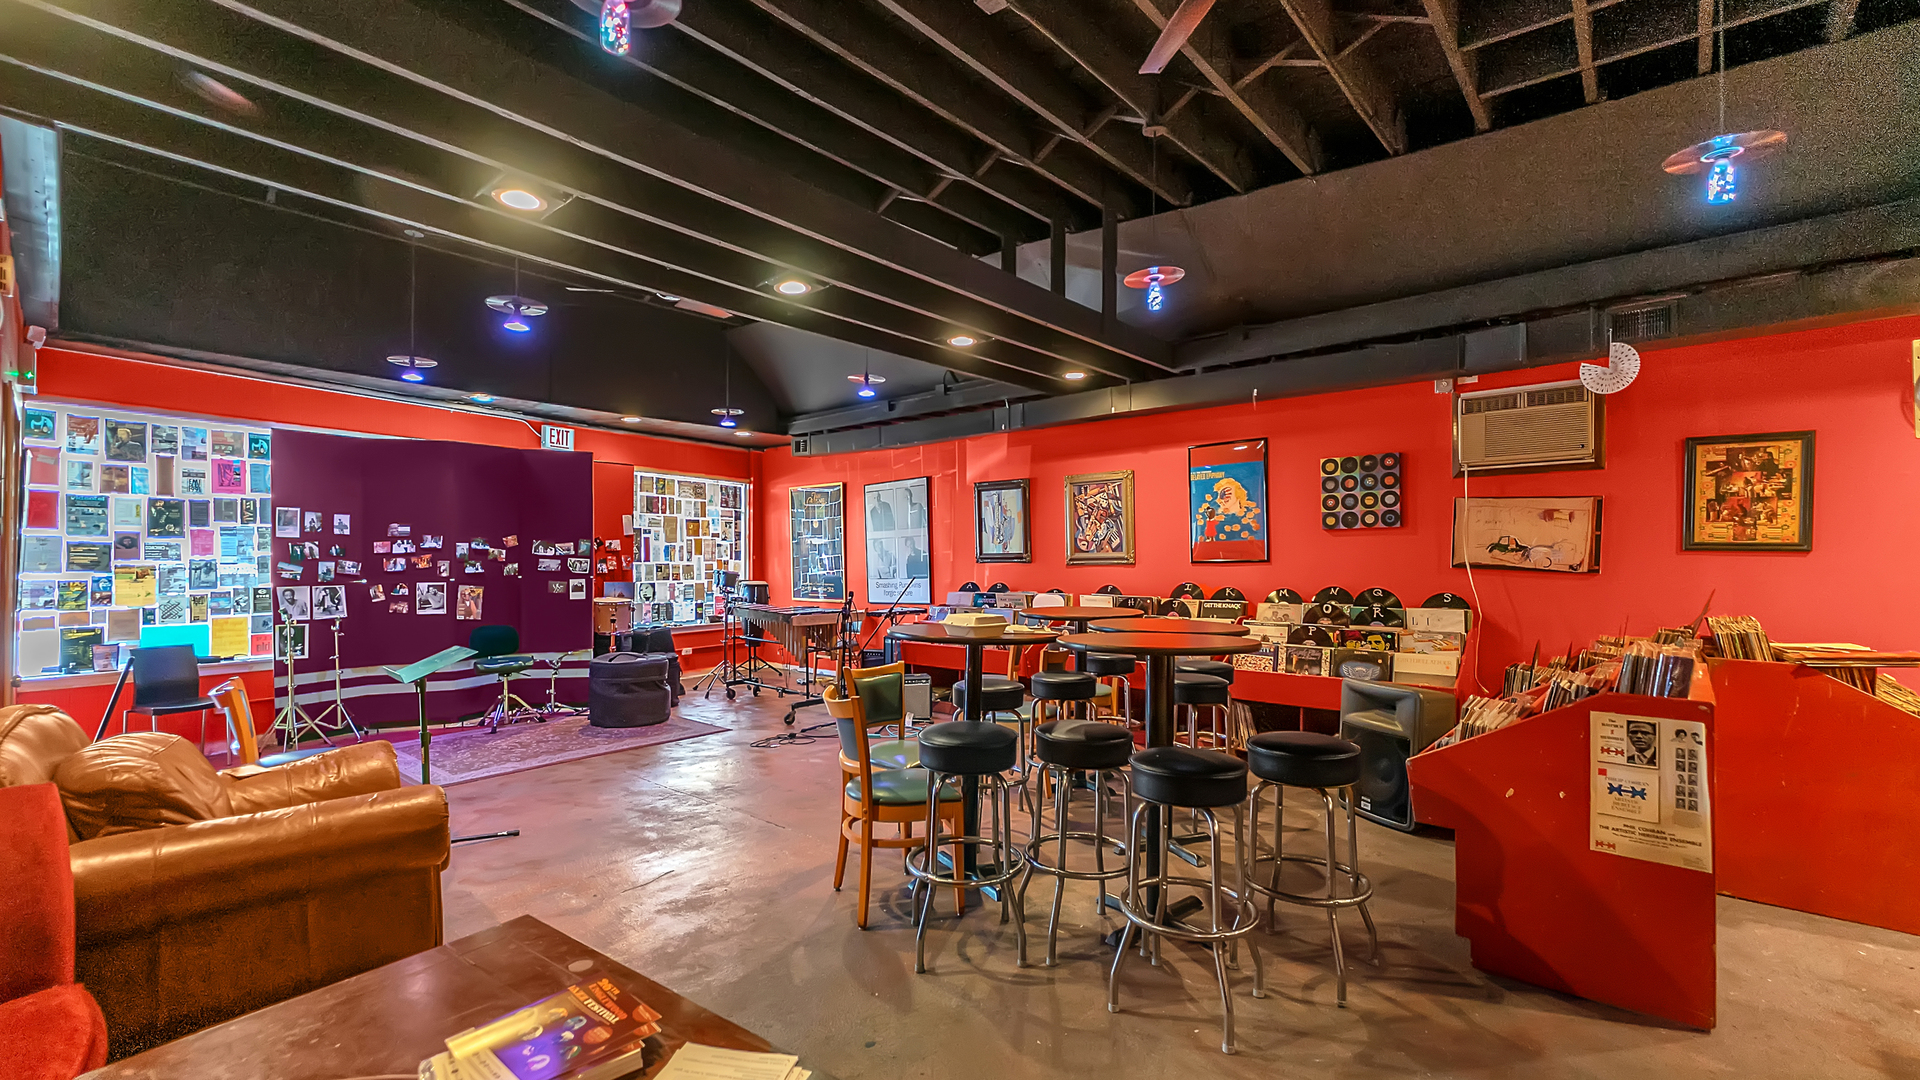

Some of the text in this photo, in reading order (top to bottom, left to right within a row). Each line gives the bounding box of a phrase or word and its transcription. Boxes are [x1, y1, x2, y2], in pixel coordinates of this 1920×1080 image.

[550, 428, 570, 446] EXIT
[875, 581, 898, 590] Smashing
[1225, 588, 1236, 597] K
[1279, 589, 1288, 597] M
[1329, 587, 1339, 595] N
[1372, 588, 1383, 597] Q
[1128, 597, 1135, 606] H
[1443, 593, 1452, 603] S
[1172, 600, 1181, 608] J
[1323, 603, 1332, 614] O
[1373, 607, 1384, 618] R
[1308, 626, 1317, 635] P
[1638, 827, 1666, 835] COHRAN
[1611, 827, 1637, 836] ARTISTIC
[1638, 832, 1668, 841] HERITAGE
[1669, 837, 1702, 847] ENSEMBLE
[567, 984, 589, 1002] JAZZ
[583, 998, 620, 1025] FESTIVAL
